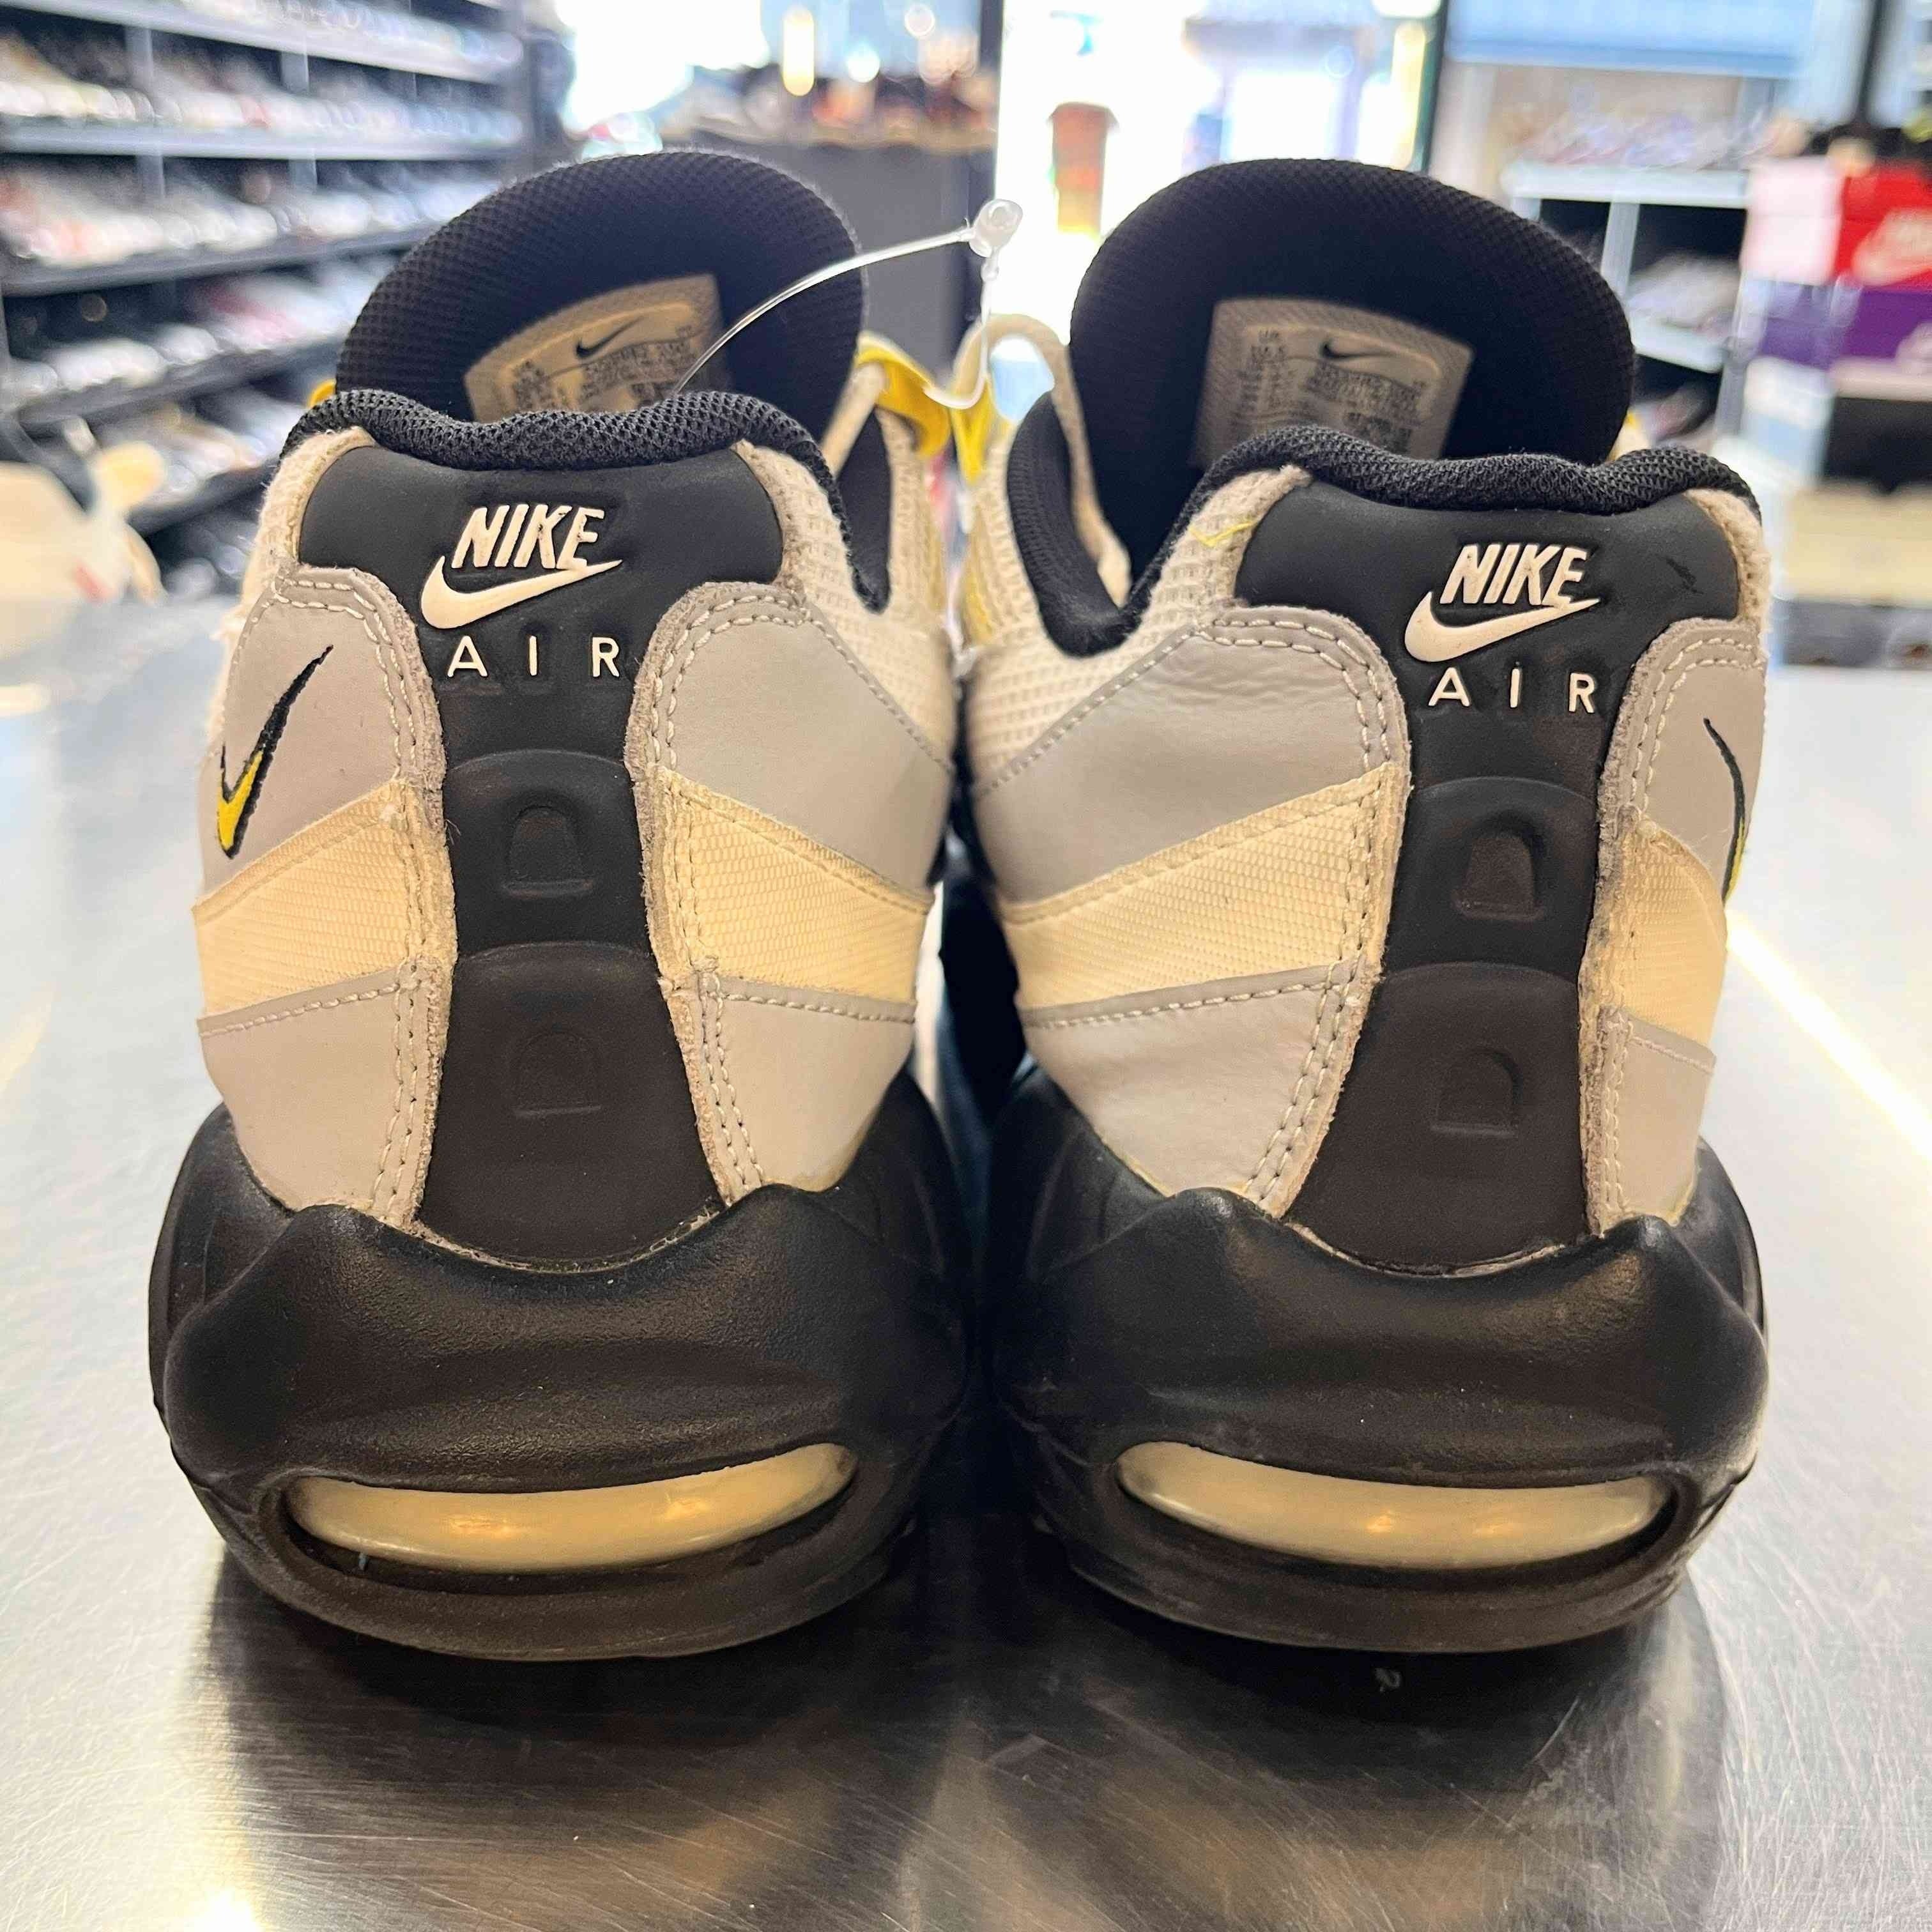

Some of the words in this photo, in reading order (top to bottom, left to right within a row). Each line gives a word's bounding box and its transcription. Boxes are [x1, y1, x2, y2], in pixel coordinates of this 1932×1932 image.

[451, 504, 605, 569] NIKE
[1439, 543, 1587, 607] NIKE
[447, 636, 620, 677] AIR
[1428, 666, 1595, 714] AIR
